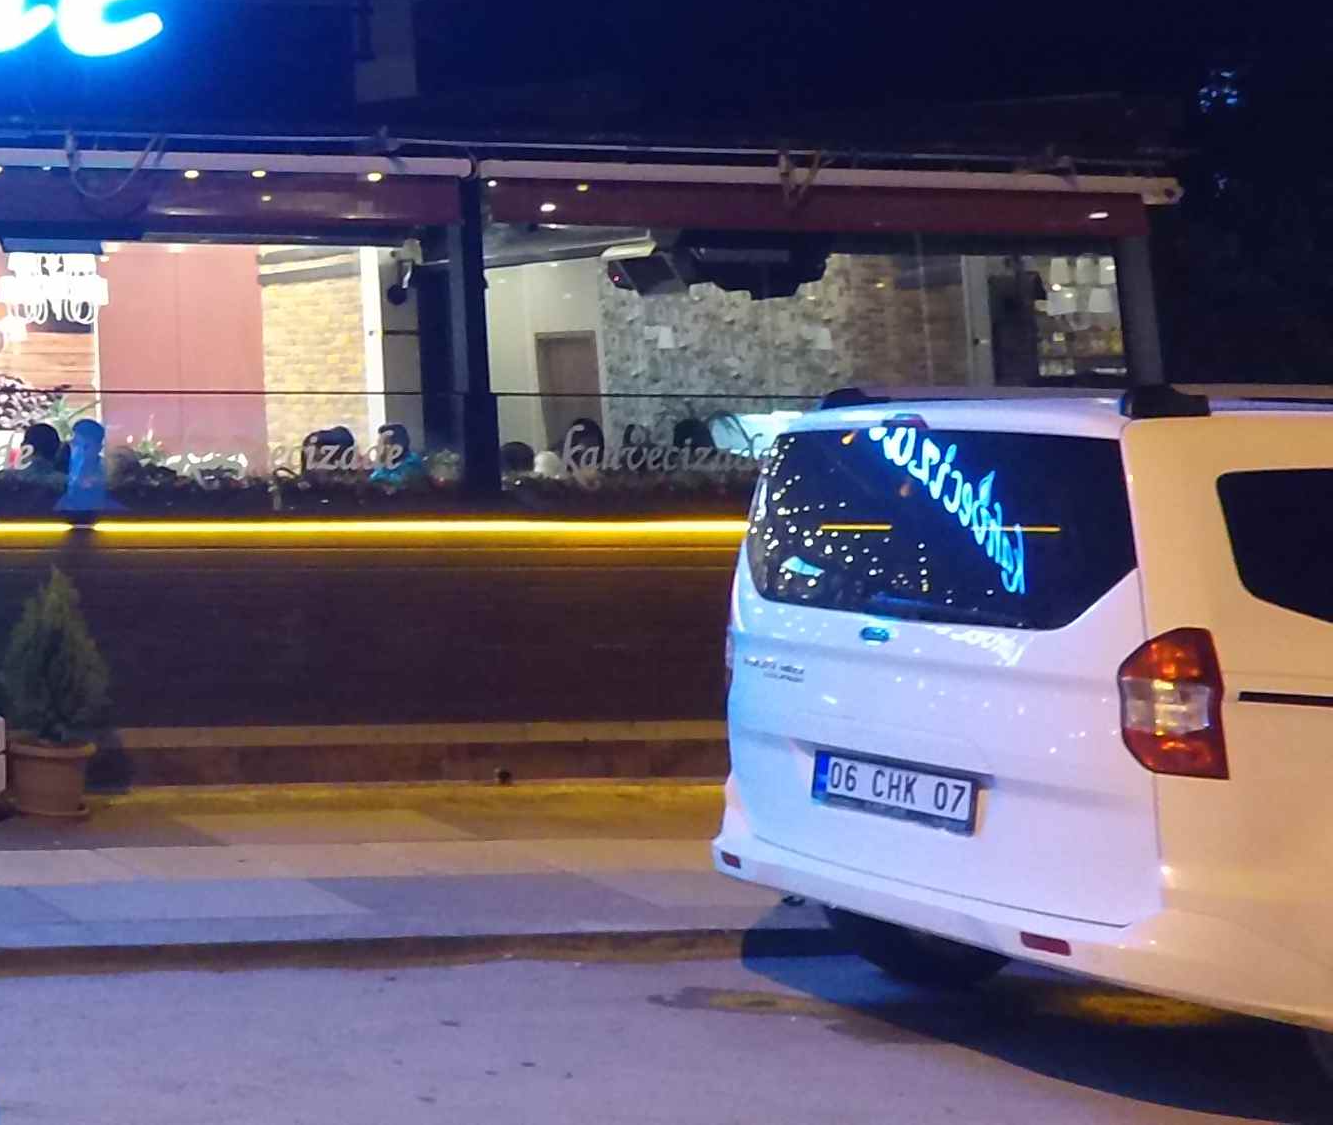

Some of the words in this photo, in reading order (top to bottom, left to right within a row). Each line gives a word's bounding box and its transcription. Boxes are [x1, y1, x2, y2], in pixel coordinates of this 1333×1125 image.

[830, 761, 858, 792] 06
[871, 768, 920, 805] CHK
[933, 781, 967, 813] 07
